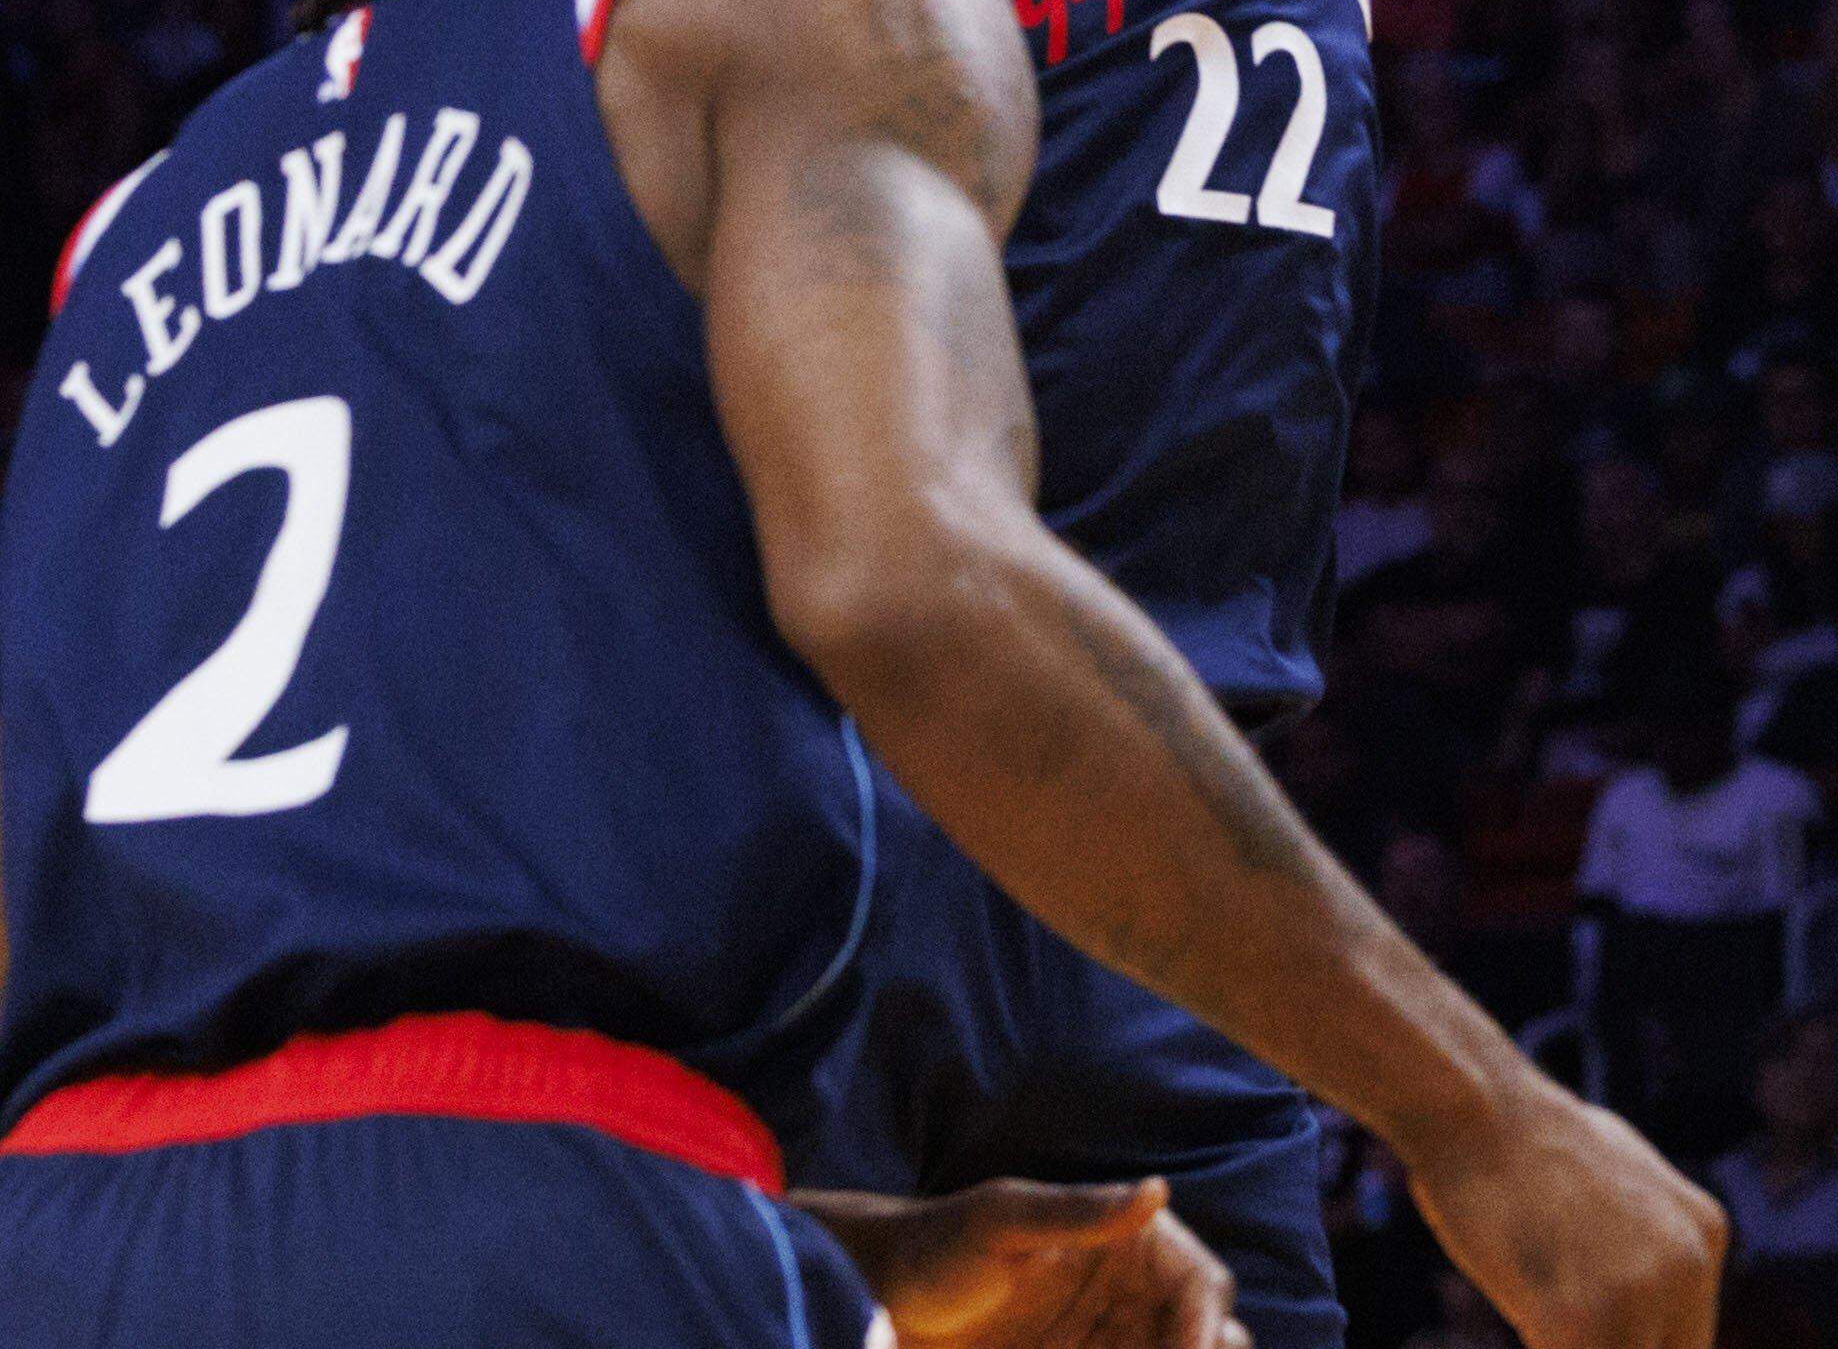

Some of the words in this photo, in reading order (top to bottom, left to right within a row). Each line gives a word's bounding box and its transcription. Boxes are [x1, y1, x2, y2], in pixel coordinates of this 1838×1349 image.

[59, 106, 534, 447] LEONARD
[1149, 11, 1336, 239] 22
[83, 394, 352, 825] 2
